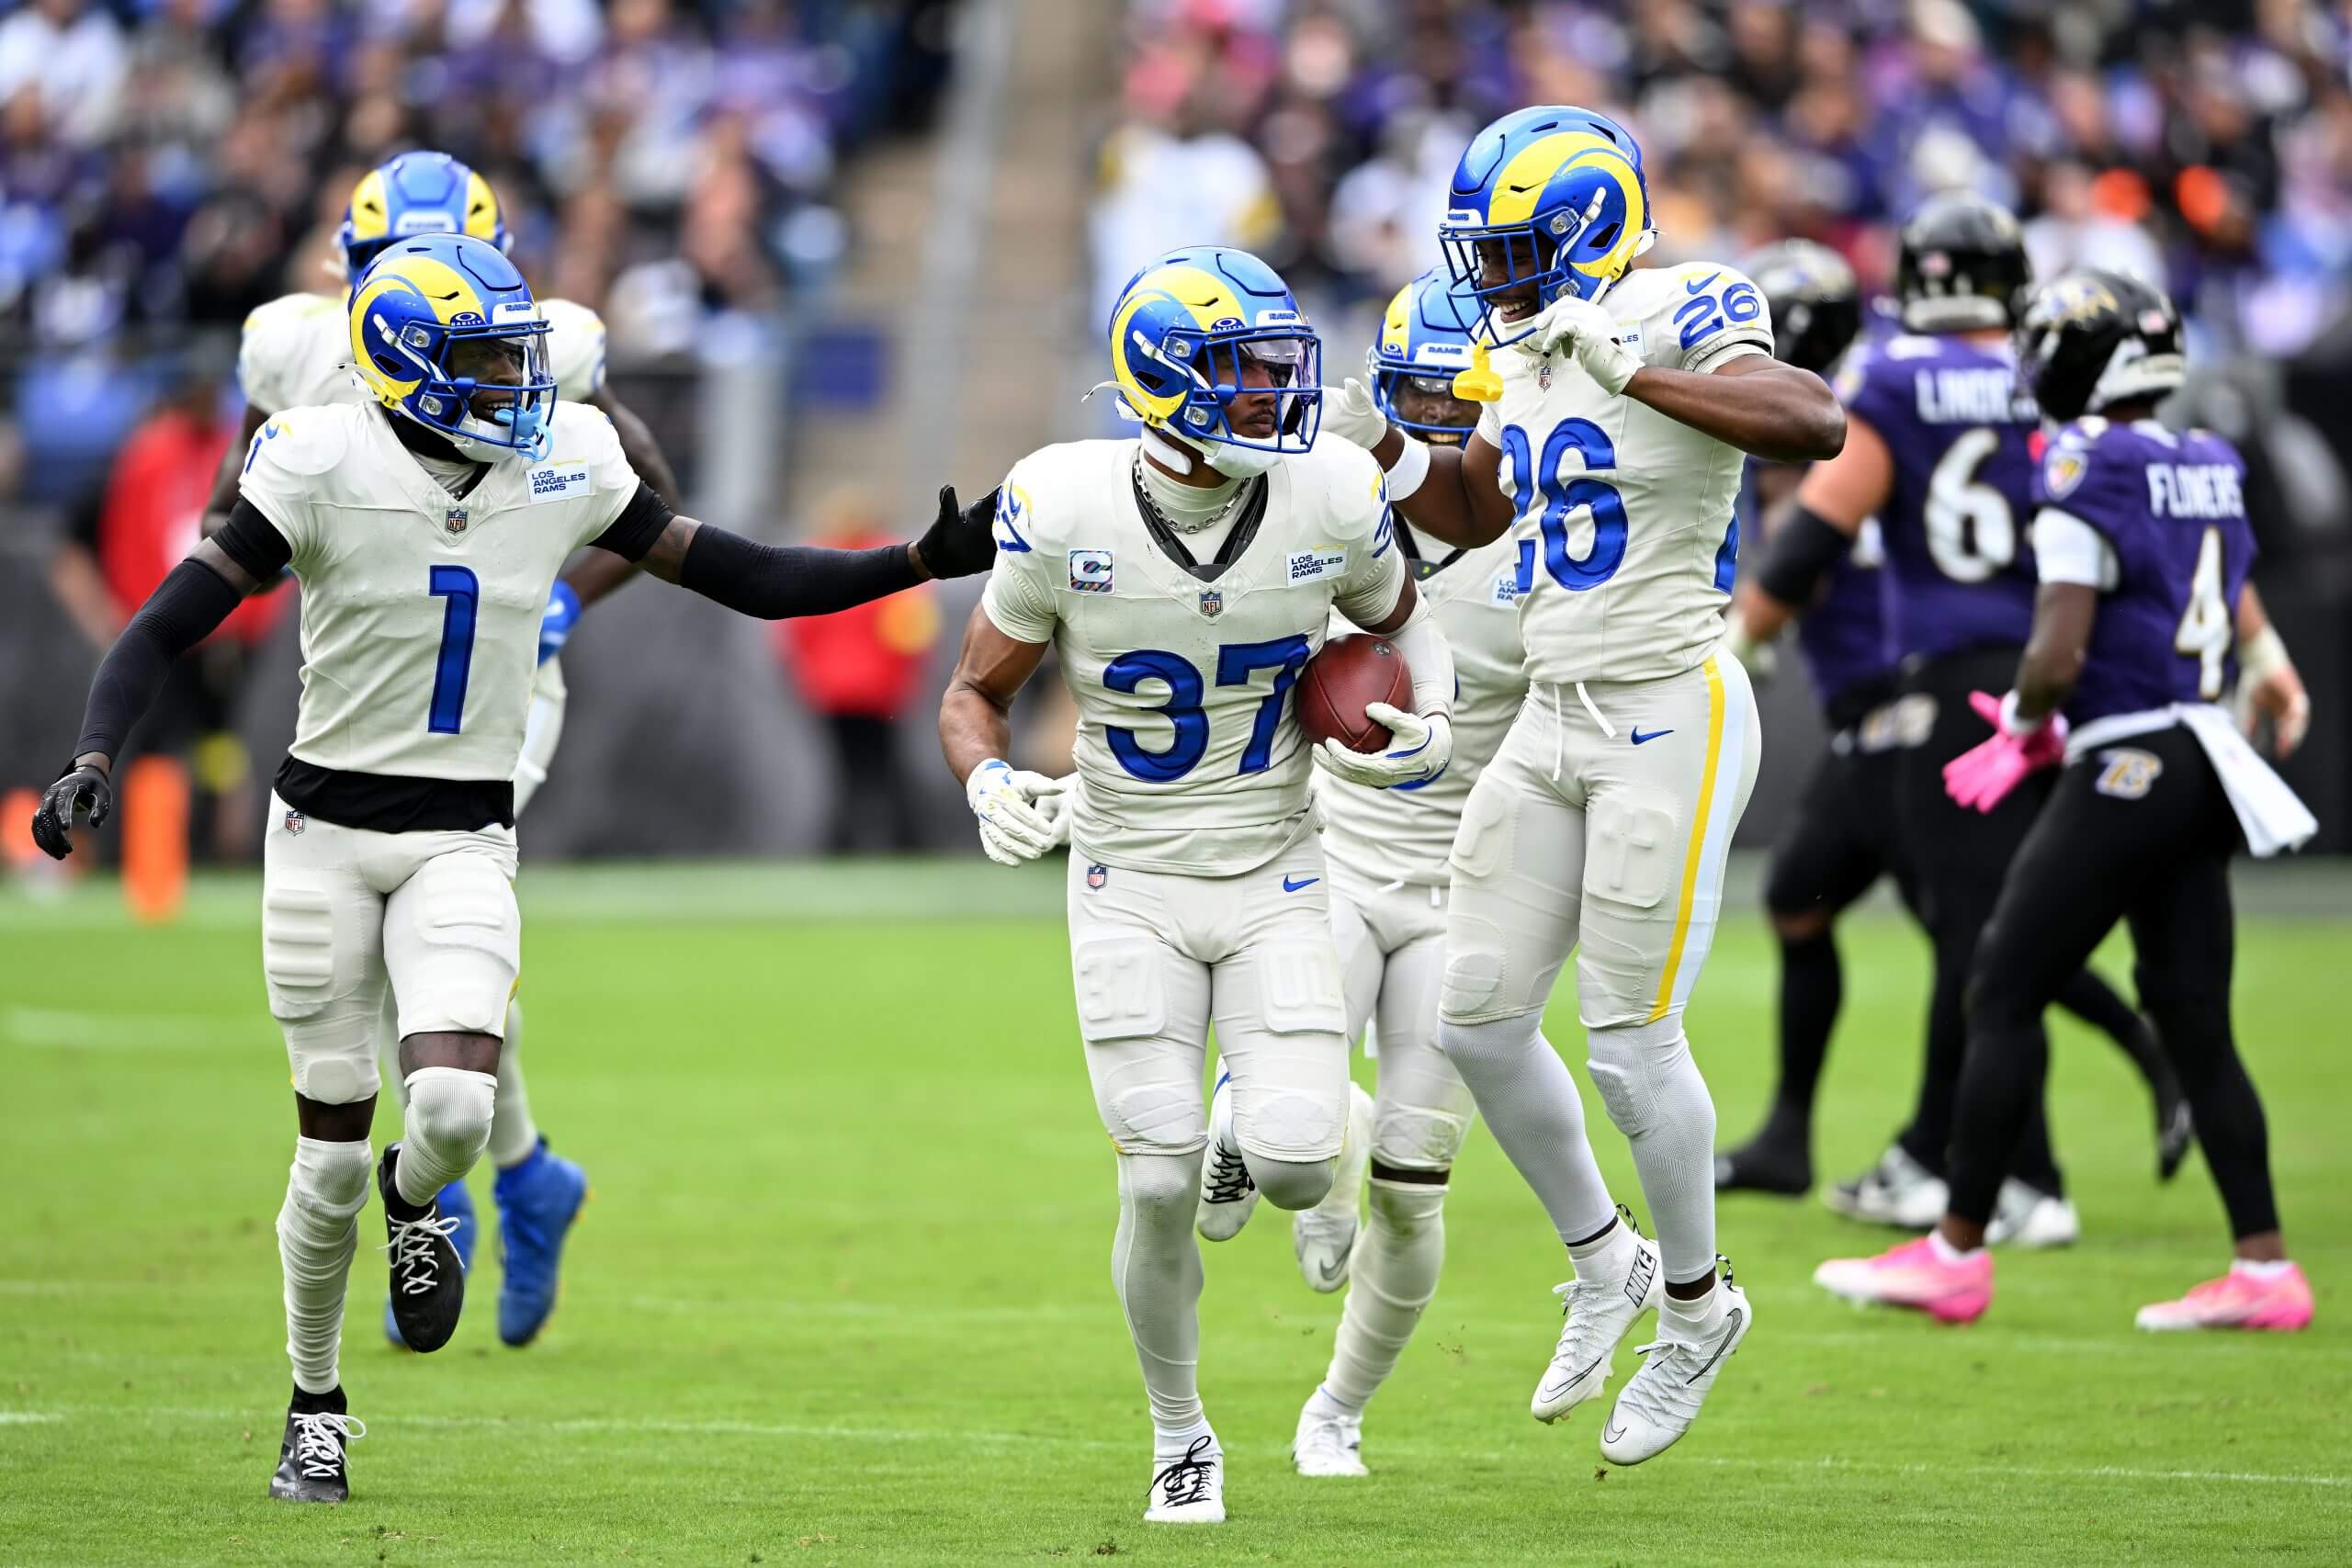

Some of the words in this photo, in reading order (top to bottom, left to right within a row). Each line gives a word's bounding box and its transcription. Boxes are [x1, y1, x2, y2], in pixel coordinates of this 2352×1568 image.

[1673, 282, 1760, 352] 26
[1428, 346, 1464, 355] RAMS
[532, 470, 555, 480] LOS
[533, 472, 586, 488] ANGELES
[534, 483, 567, 494] RAMS
[2146, 463, 2245, 518] FLOWERS
[1498, 417, 1629, 592] 26
[1924, 426, 2015, 583] 6
[1071, 551, 1113, 583] C
[1291, 554, 1313, 565] LOS
[1292, 557, 1343, 572] ANGELES
[1292, 566, 1323, 580] RAMS
[1498, 579, 1517, 587] LO
[2174, 524, 2233, 701] 4
[427, 564, 480, 735] 1
[1102, 633, 1311, 784] 37
[1624, 1245, 1657, 1307] NIKE
